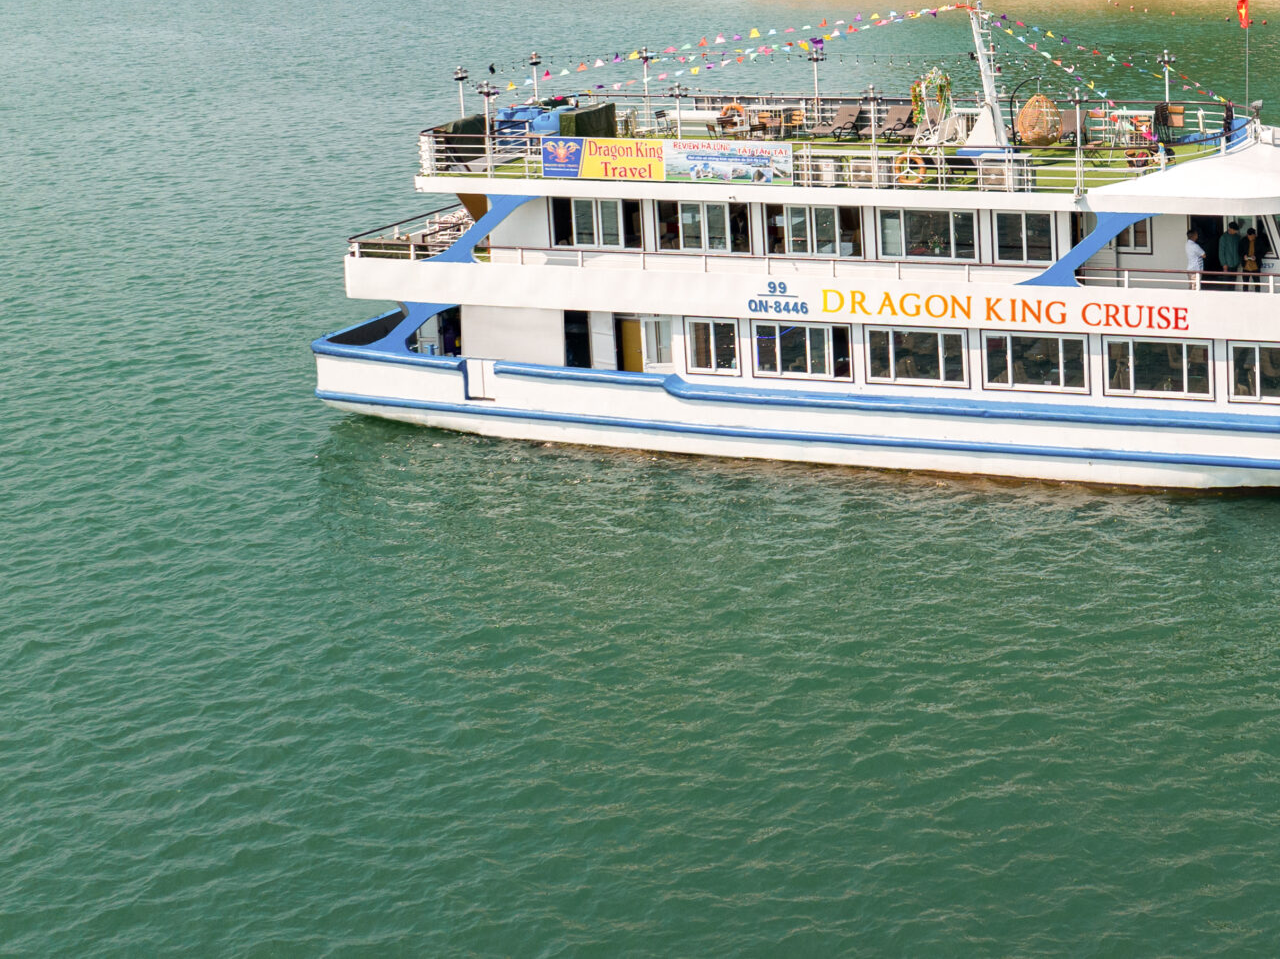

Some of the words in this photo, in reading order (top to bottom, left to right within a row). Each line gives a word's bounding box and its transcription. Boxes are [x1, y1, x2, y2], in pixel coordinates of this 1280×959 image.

[588, 140, 633, 160] Dragon
[636, 142, 664, 162] King
[673, 141, 699, 150] REVIEW
[601, 161, 652, 178] Travel
[767, 281, 787, 294] 99
[748, 299, 808, 314] QN-8446
[822, 289, 972, 319] DRAGON
[985, 297, 1067, 325] KING
[1081, 302, 1189, 331] CRUISE
